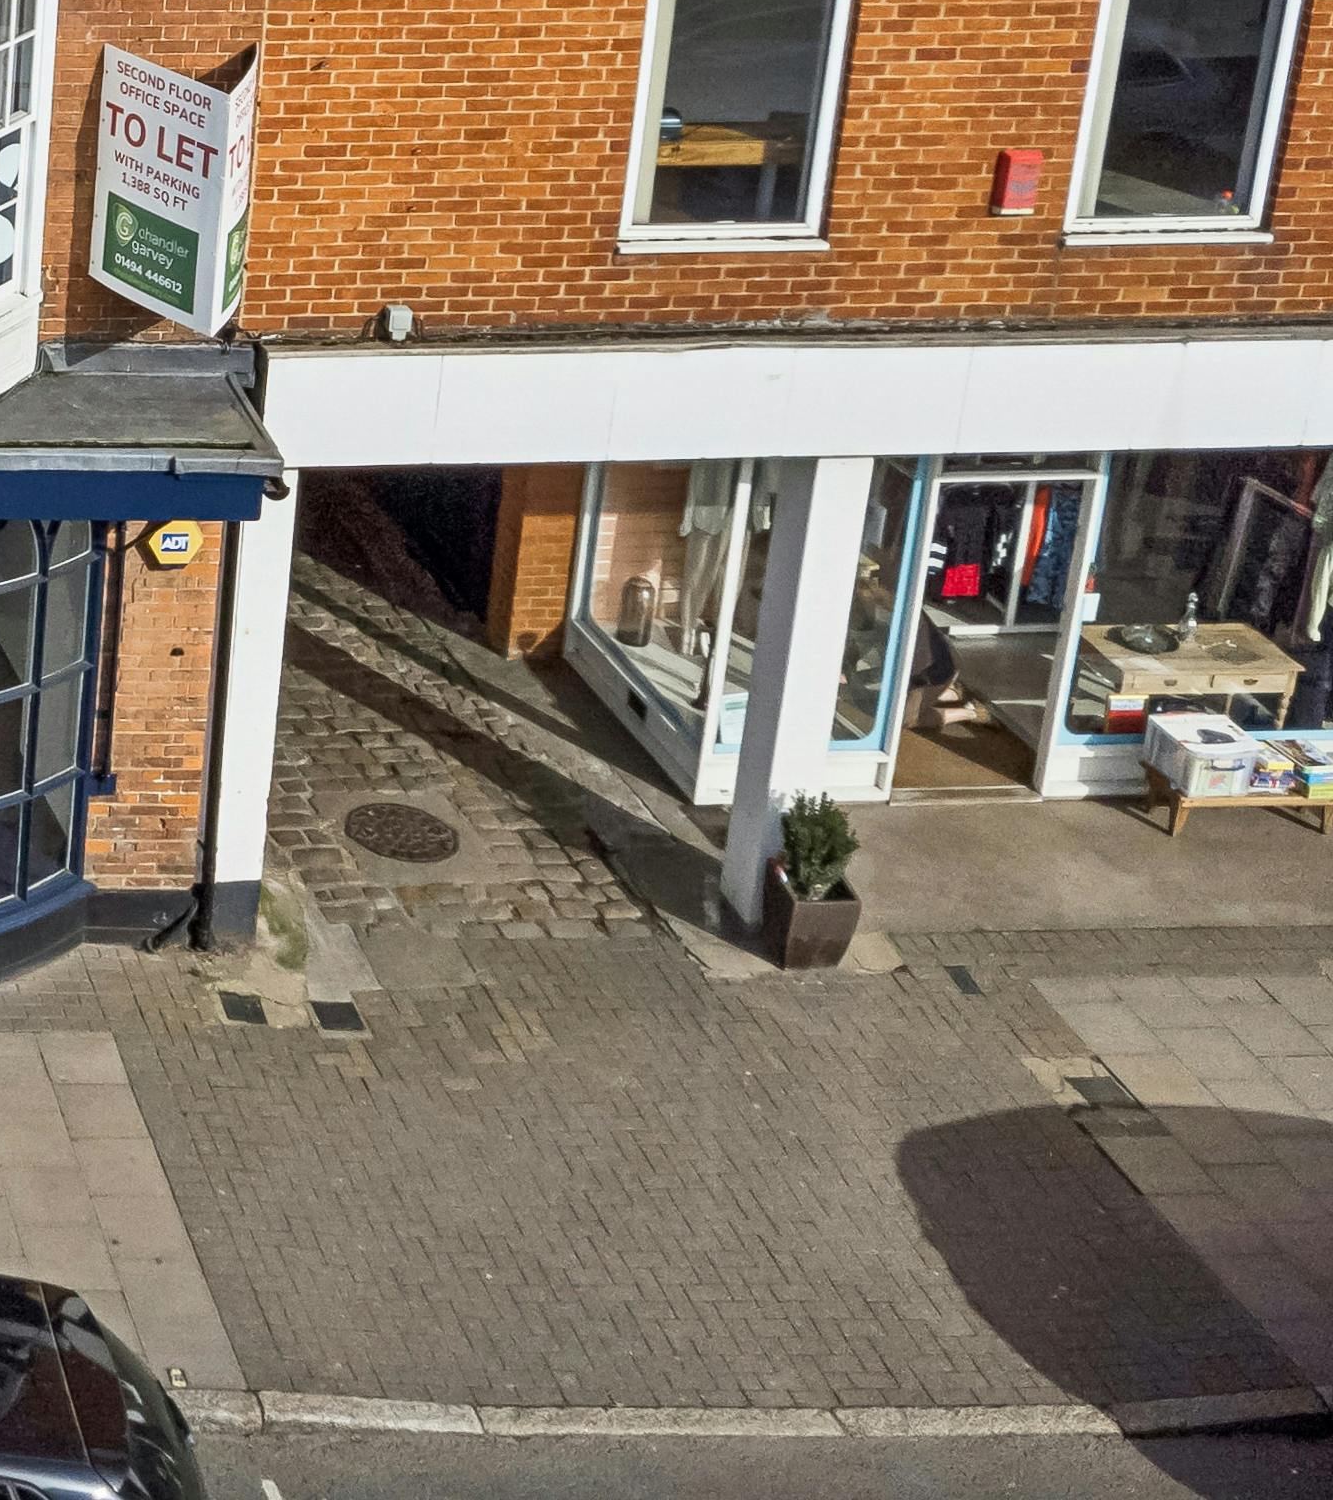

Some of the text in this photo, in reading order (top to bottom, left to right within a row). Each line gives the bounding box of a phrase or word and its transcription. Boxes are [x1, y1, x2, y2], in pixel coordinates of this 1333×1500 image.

[117, 60, 166, 92] SECOND
[169, 83, 212, 112] FLOOR
[119, 81, 161, 110] OFFICE
[163, 100, 206, 129] SPACE
[106, 101, 219, 180] TO LET
[114, 150, 144, 174] WITH
[146, 165, 201, 200] PARKING
[122, 172, 188, 211] 1,388 SQ FT
[132, 240, 175, 270] garvey
[138, 226, 190, 259] chandler
[114, 253, 143, 276] 01494
[145, 269, 183, 295] 446612
[161, 535, 189, 551] ADT
